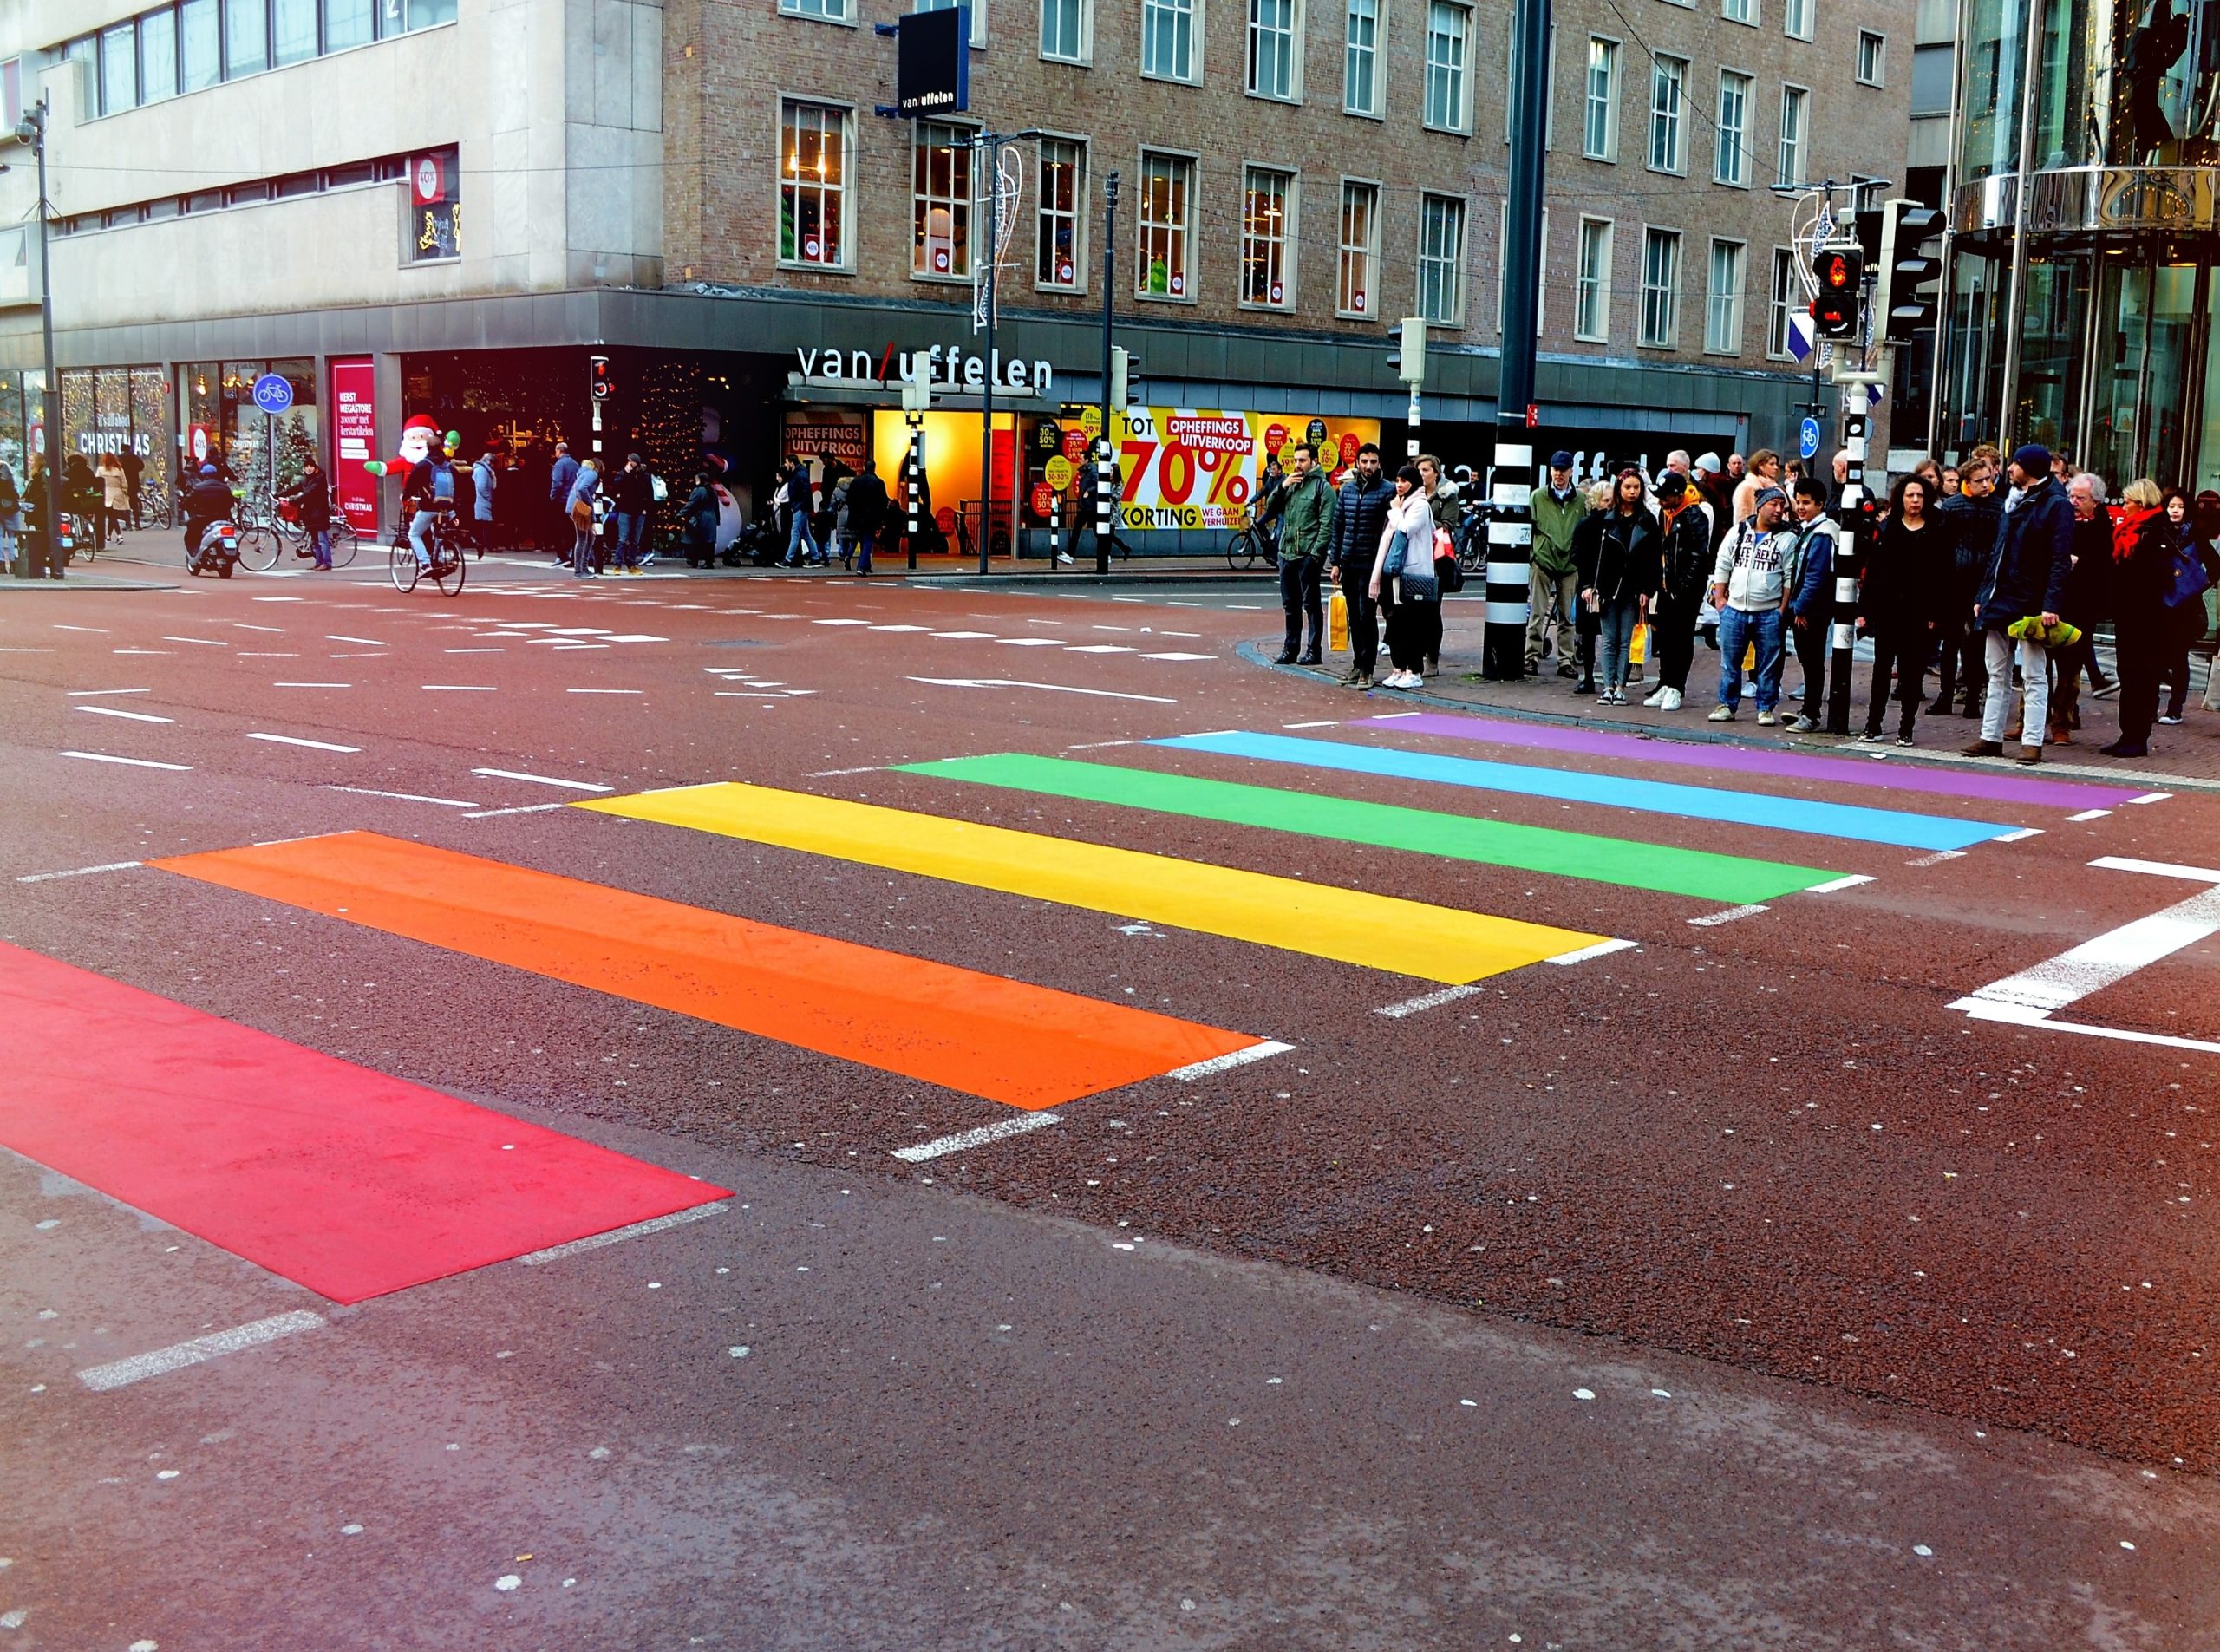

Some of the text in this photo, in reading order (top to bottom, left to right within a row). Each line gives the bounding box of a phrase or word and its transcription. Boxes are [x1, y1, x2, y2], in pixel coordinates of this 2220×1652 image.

[340, 392, 356, 402] KERST
[340, 403, 373, 414] MEGASTORE
[1122, 417, 1153, 435] TOT
[1170, 420, 1239, 434] OPHEFFINGS
[785, 428, 859, 439] OPHEFFINGS
[1180, 434, 1251, 453] UITVERKOOP
[1120, 441, 1250, 506] 70%
[344, 502, 373, 512] CHRISTMAS
[1218, 507, 1239, 516] GAAN
[1120, 507, 1197, 526] KORTING
